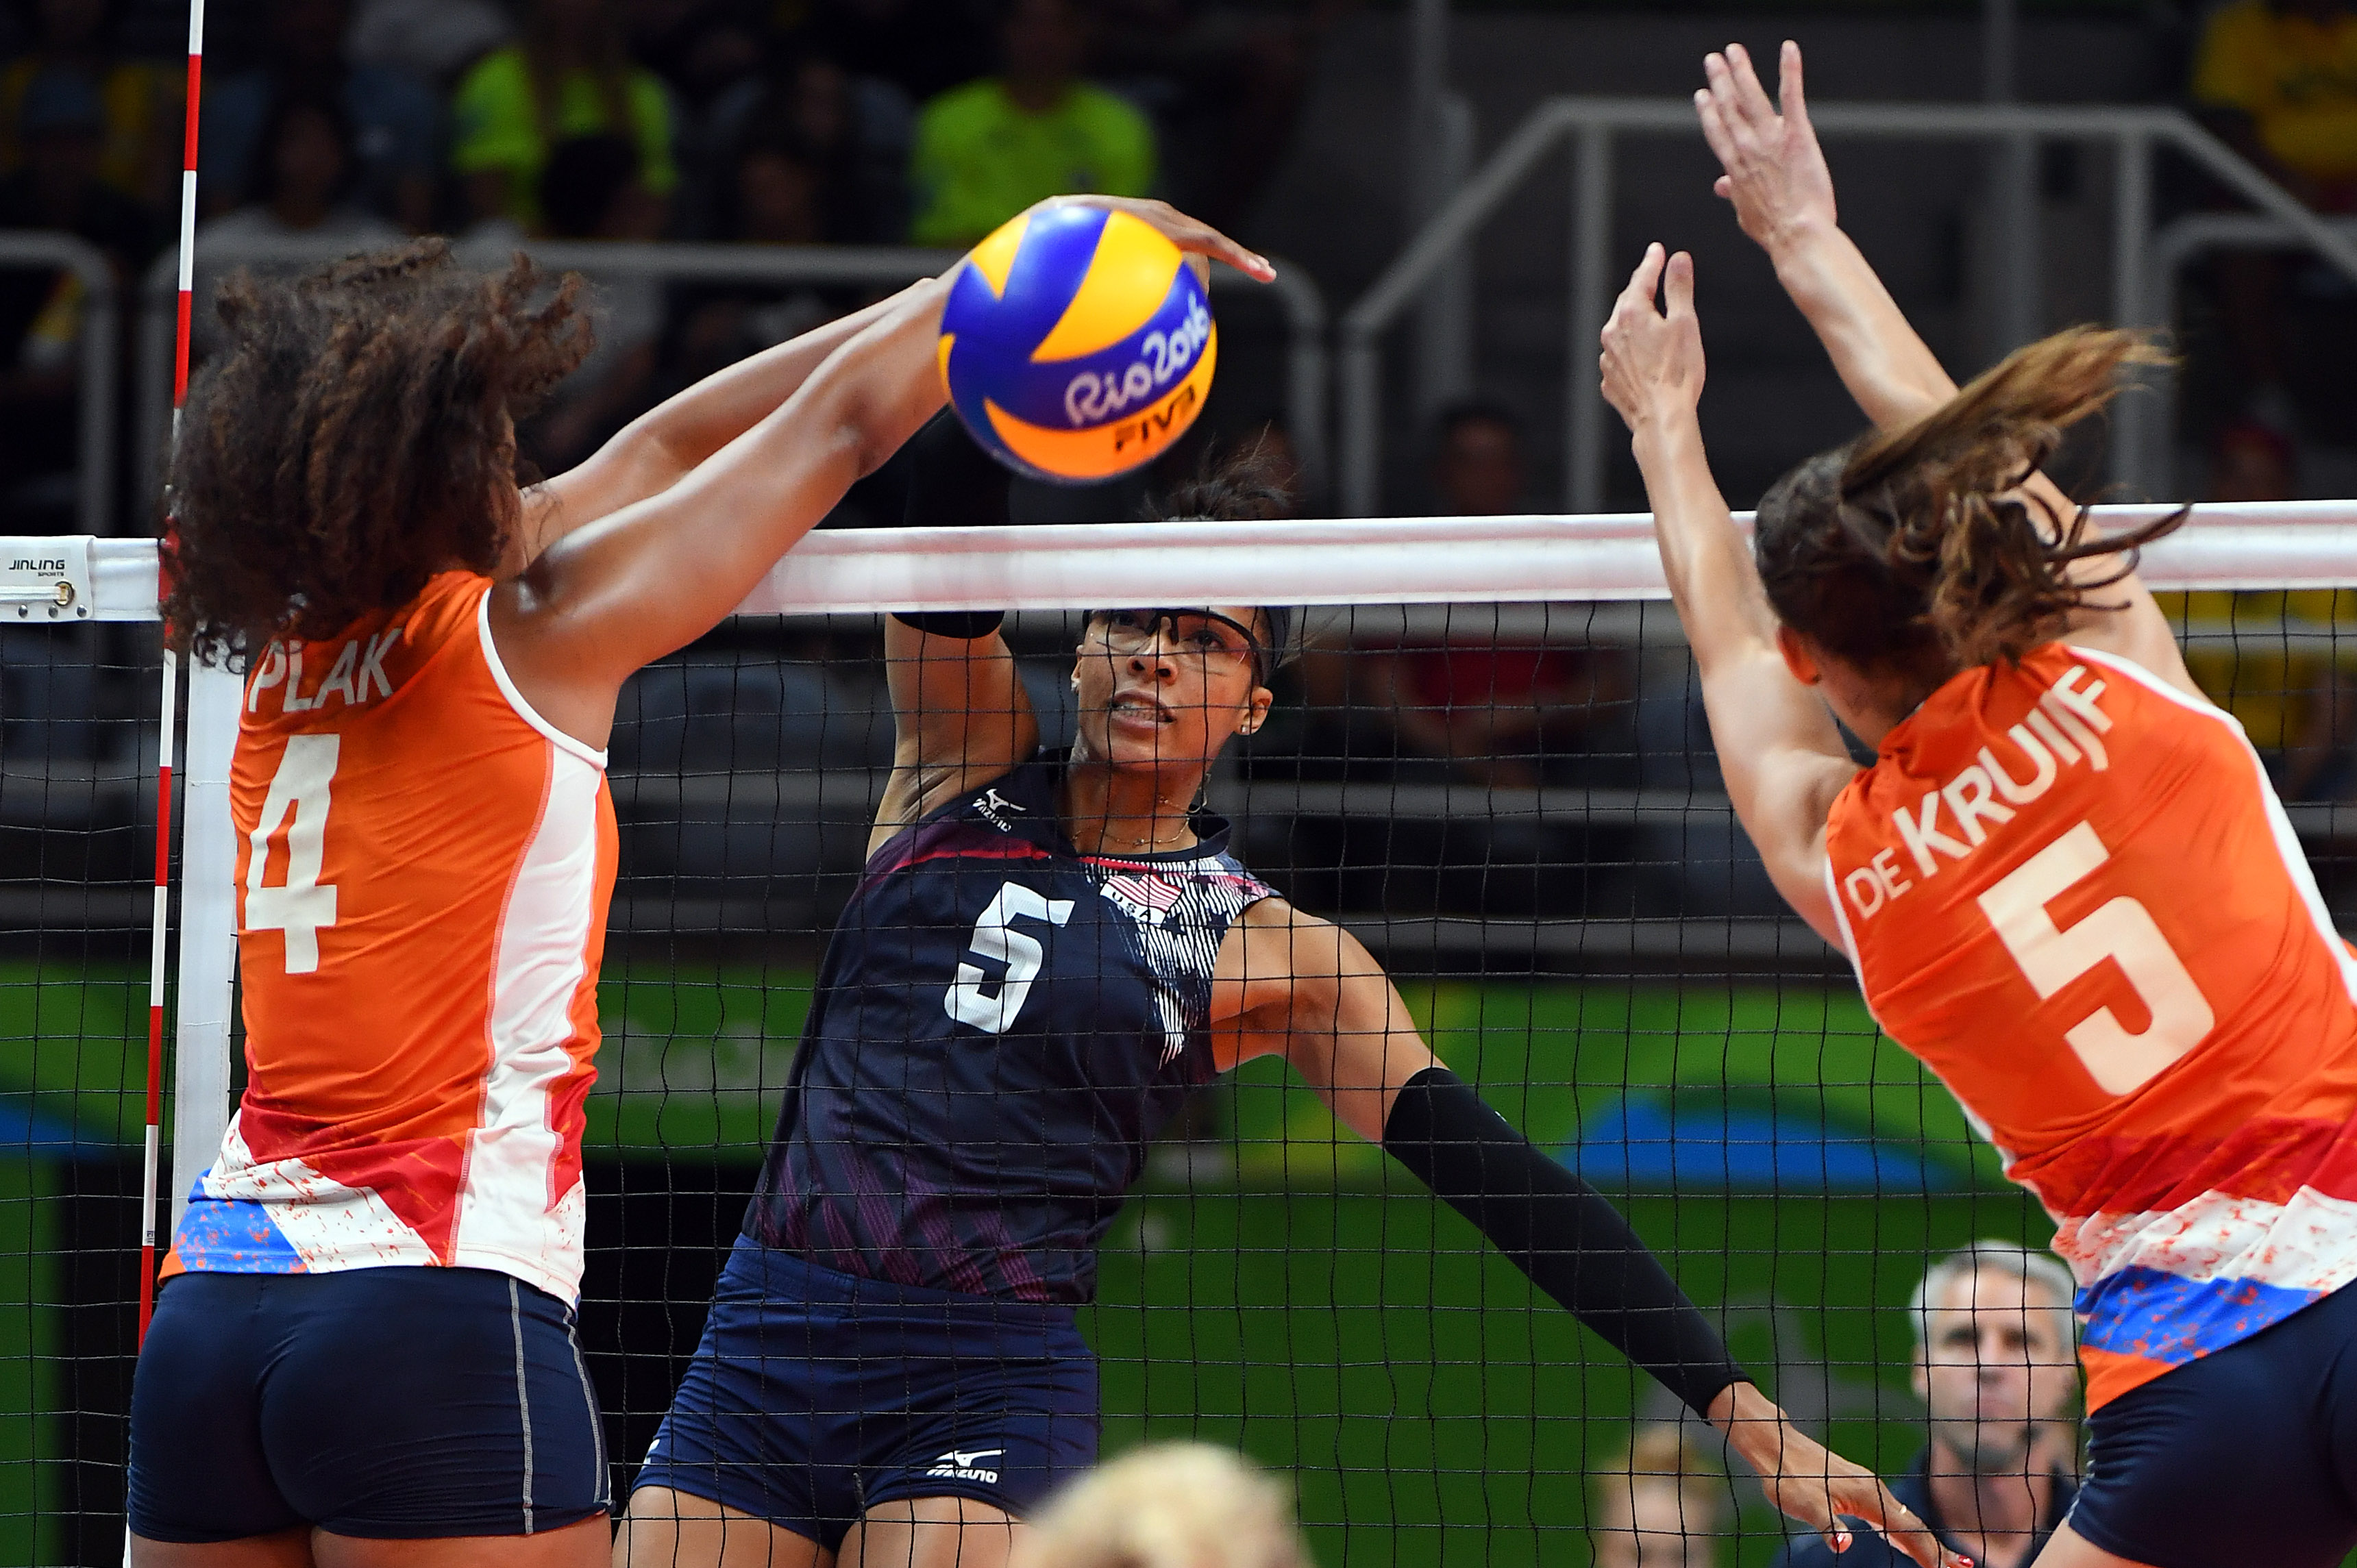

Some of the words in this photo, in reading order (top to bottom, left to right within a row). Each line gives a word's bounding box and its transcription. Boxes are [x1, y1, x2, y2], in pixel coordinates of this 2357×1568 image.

[8, 559, 65, 571] JINLING
[247, 627, 404, 713] PLAK
[245, 733, 341, 975] 4
[1844, 846, 1914, 920] DE
[1892, 664, 2113, 879] KRUIJF
[943, 880, 1076, 1034] 5
[1111, 891, 1152, 921] USA
[1976, 819, 2216, 1097] 5
